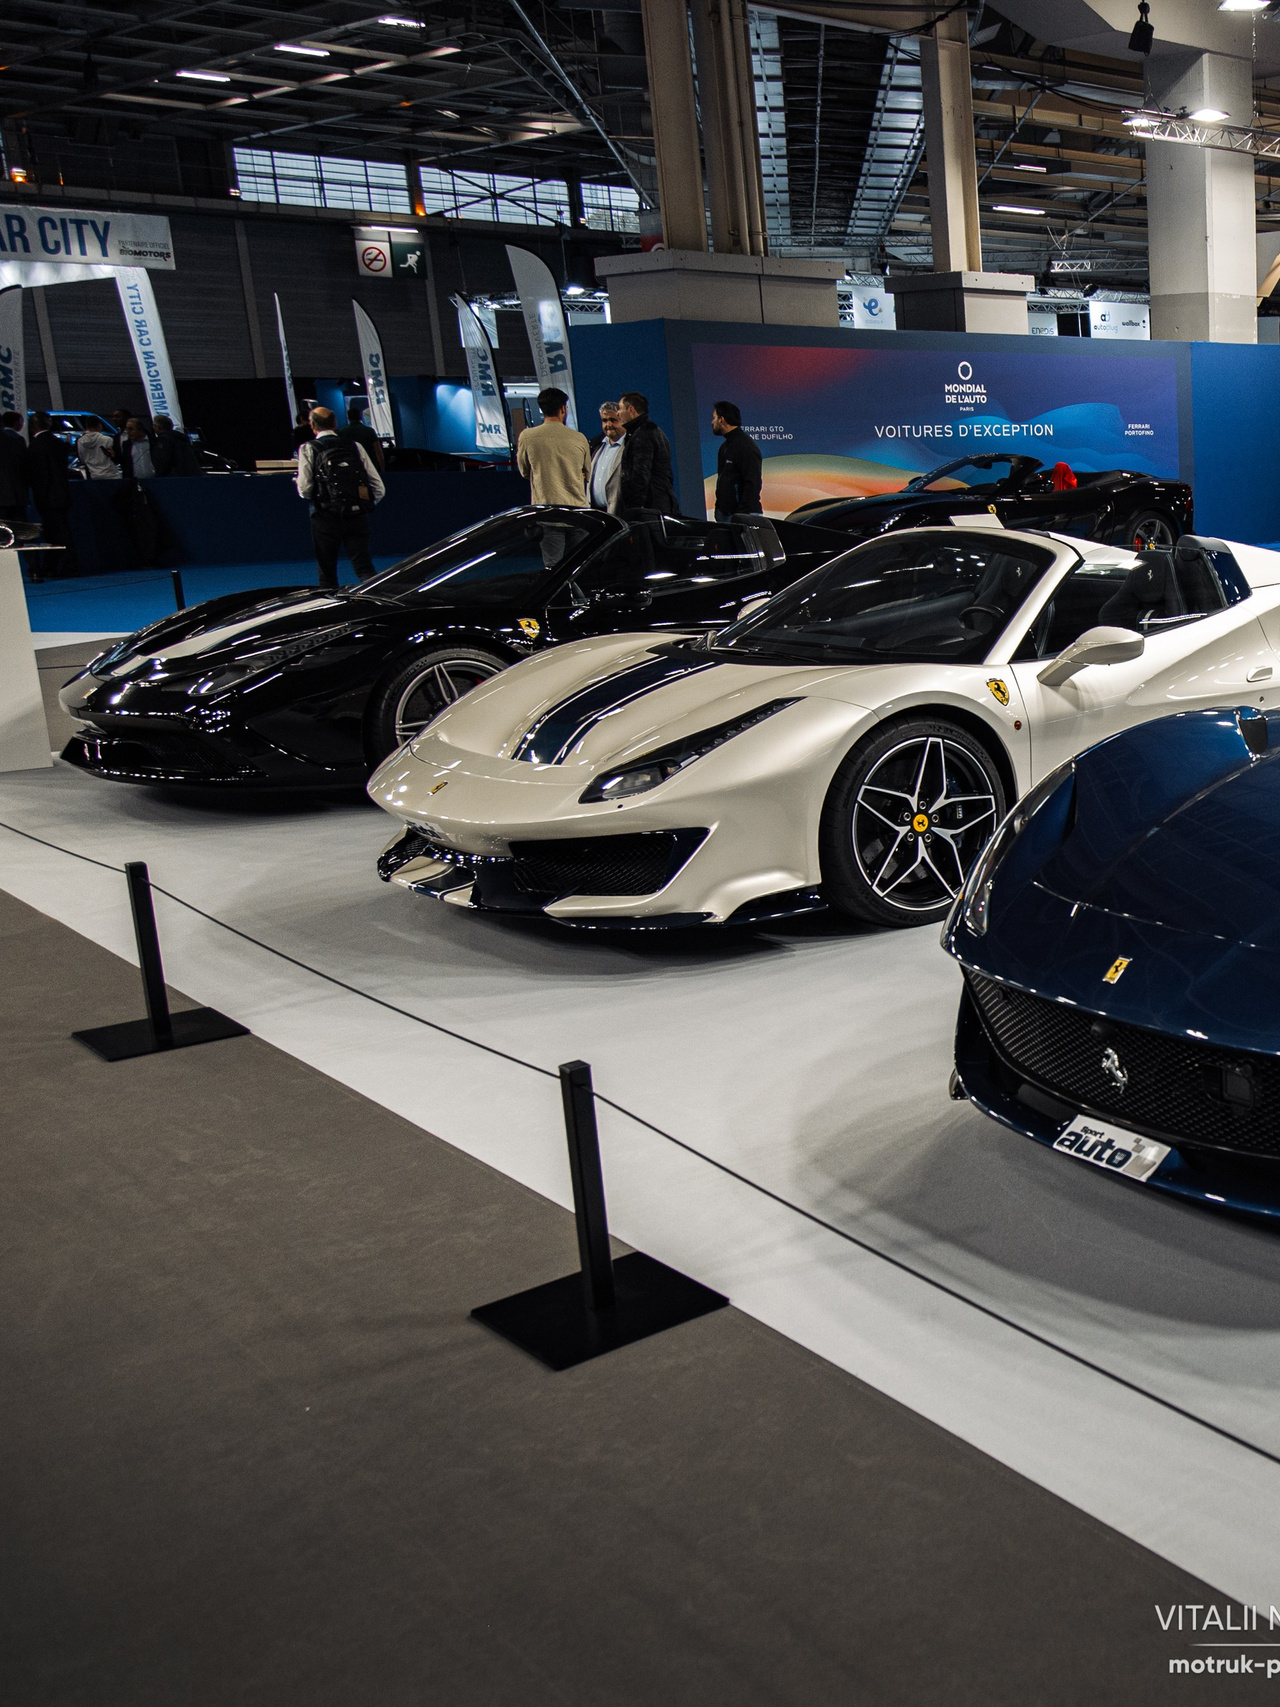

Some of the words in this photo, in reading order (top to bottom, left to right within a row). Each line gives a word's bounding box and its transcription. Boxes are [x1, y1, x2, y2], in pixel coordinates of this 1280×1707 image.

[0, 214, 31, 253] R
[37, 216, 111, 257] CITY
[944, 384, 987, 393] MONDIAL
[945, 395, 957, 403] DE
[958, 395, 987, 403] L'AUTO
[875, 425, 954, 438] VOITURES
[958, 424, 1054, 437] D'EXCEPTION
[1080, 1126, 1105, 1138] Sport
[1057, 1131, 1132, 1169] auto
